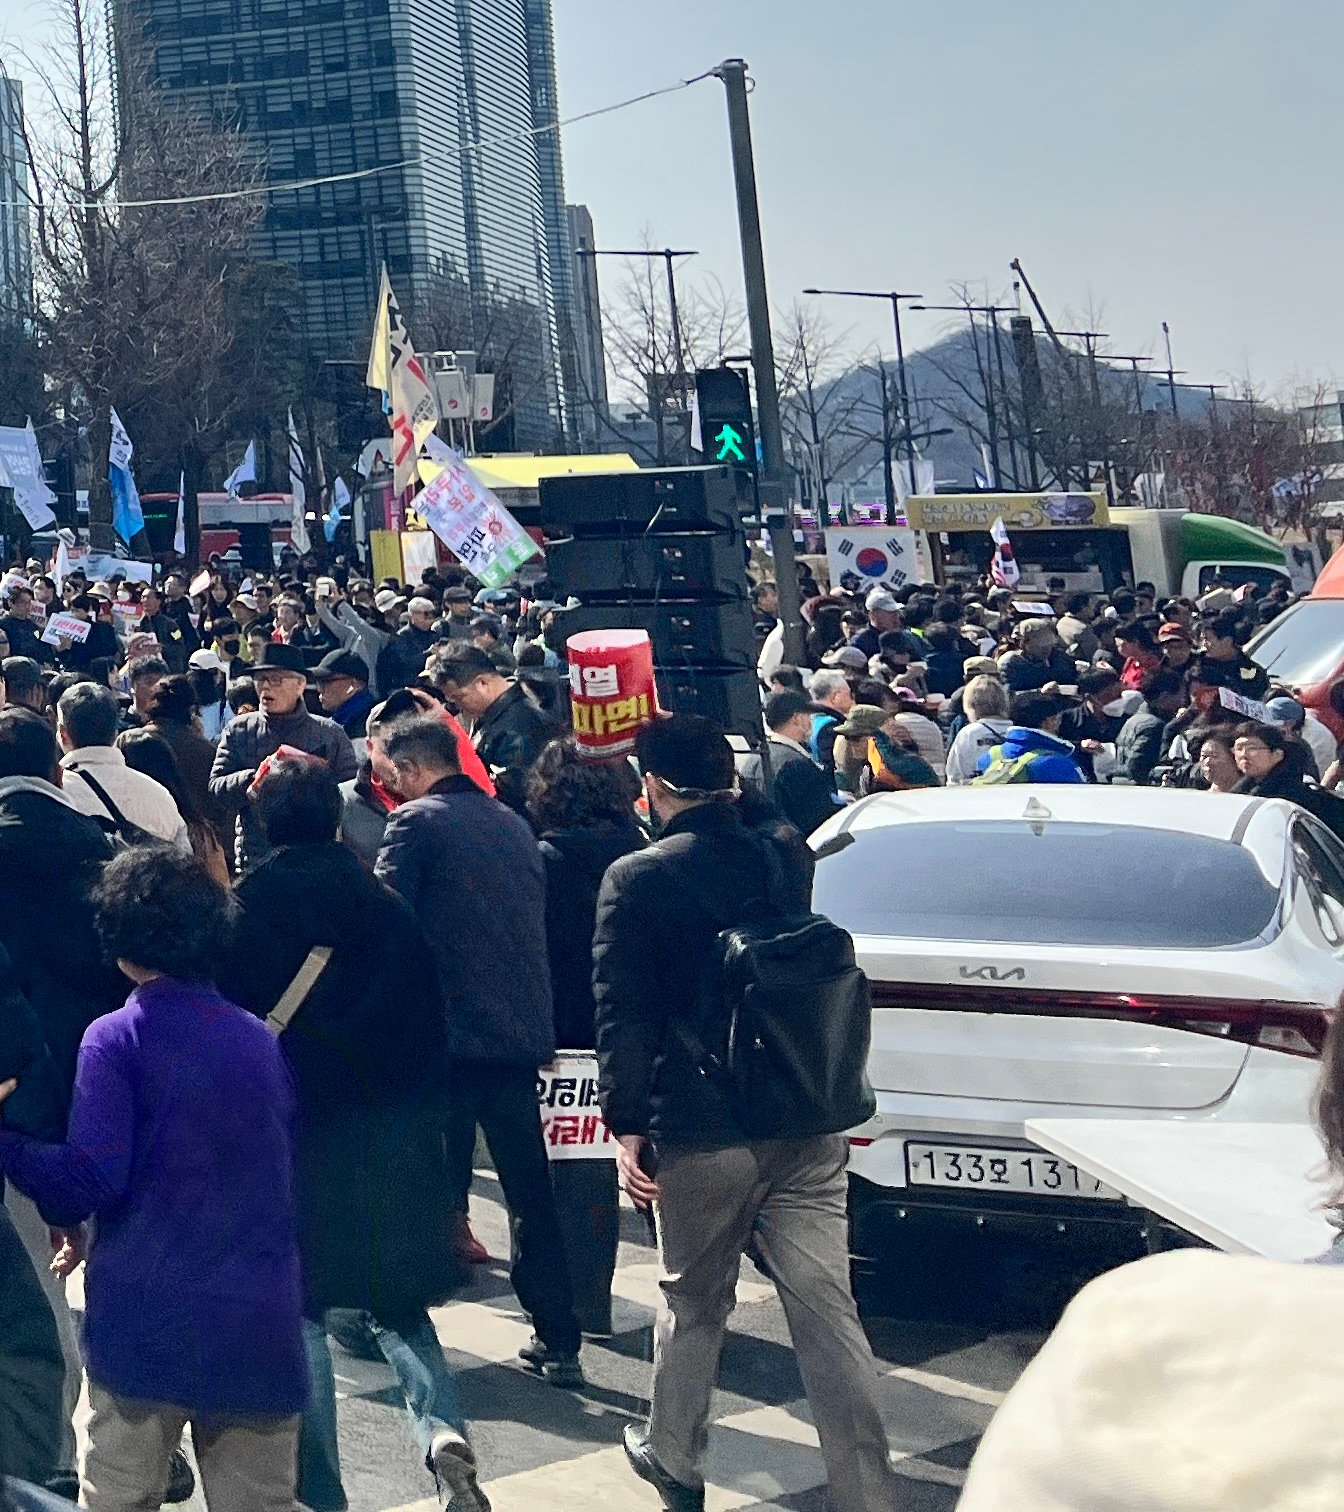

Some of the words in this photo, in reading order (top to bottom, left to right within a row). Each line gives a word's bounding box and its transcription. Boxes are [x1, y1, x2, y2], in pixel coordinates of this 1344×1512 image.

[569, 663, 621, 697] 열
[572, 692, 648, 736] 파면!
[923, 1151, 1010, 1185] 133호
[1020, 1157, 1104, 1192] 131
